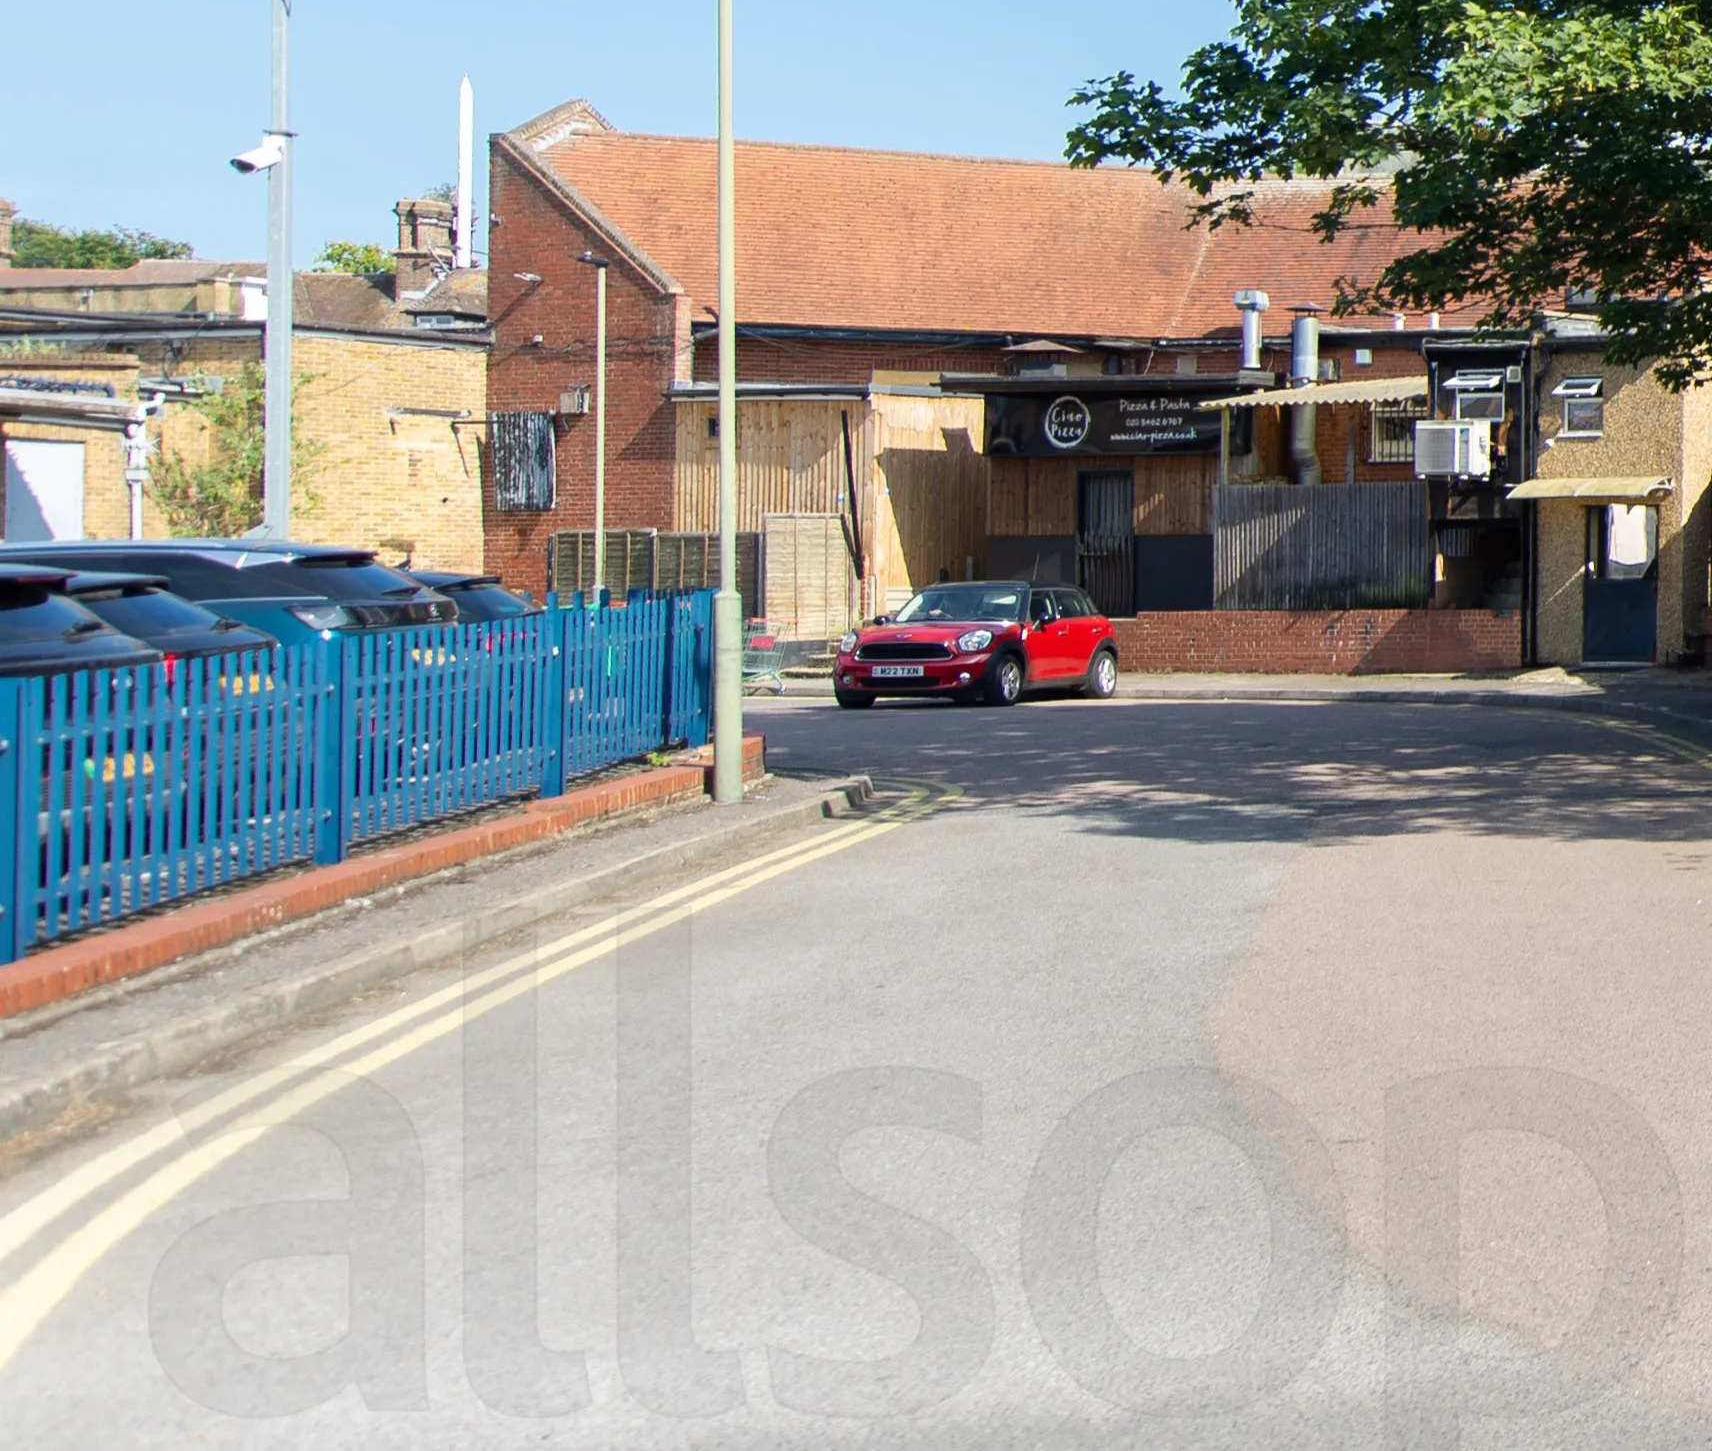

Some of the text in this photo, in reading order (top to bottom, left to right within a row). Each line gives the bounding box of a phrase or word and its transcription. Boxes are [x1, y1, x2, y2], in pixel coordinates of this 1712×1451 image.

[1120, 397, 1191, 412] Pizza & Pasta
[1052, 406, 1084, 423] Ciao
[1051, 423, 1083, 438] Pizza
[900, 667, 919, 675] TXN
